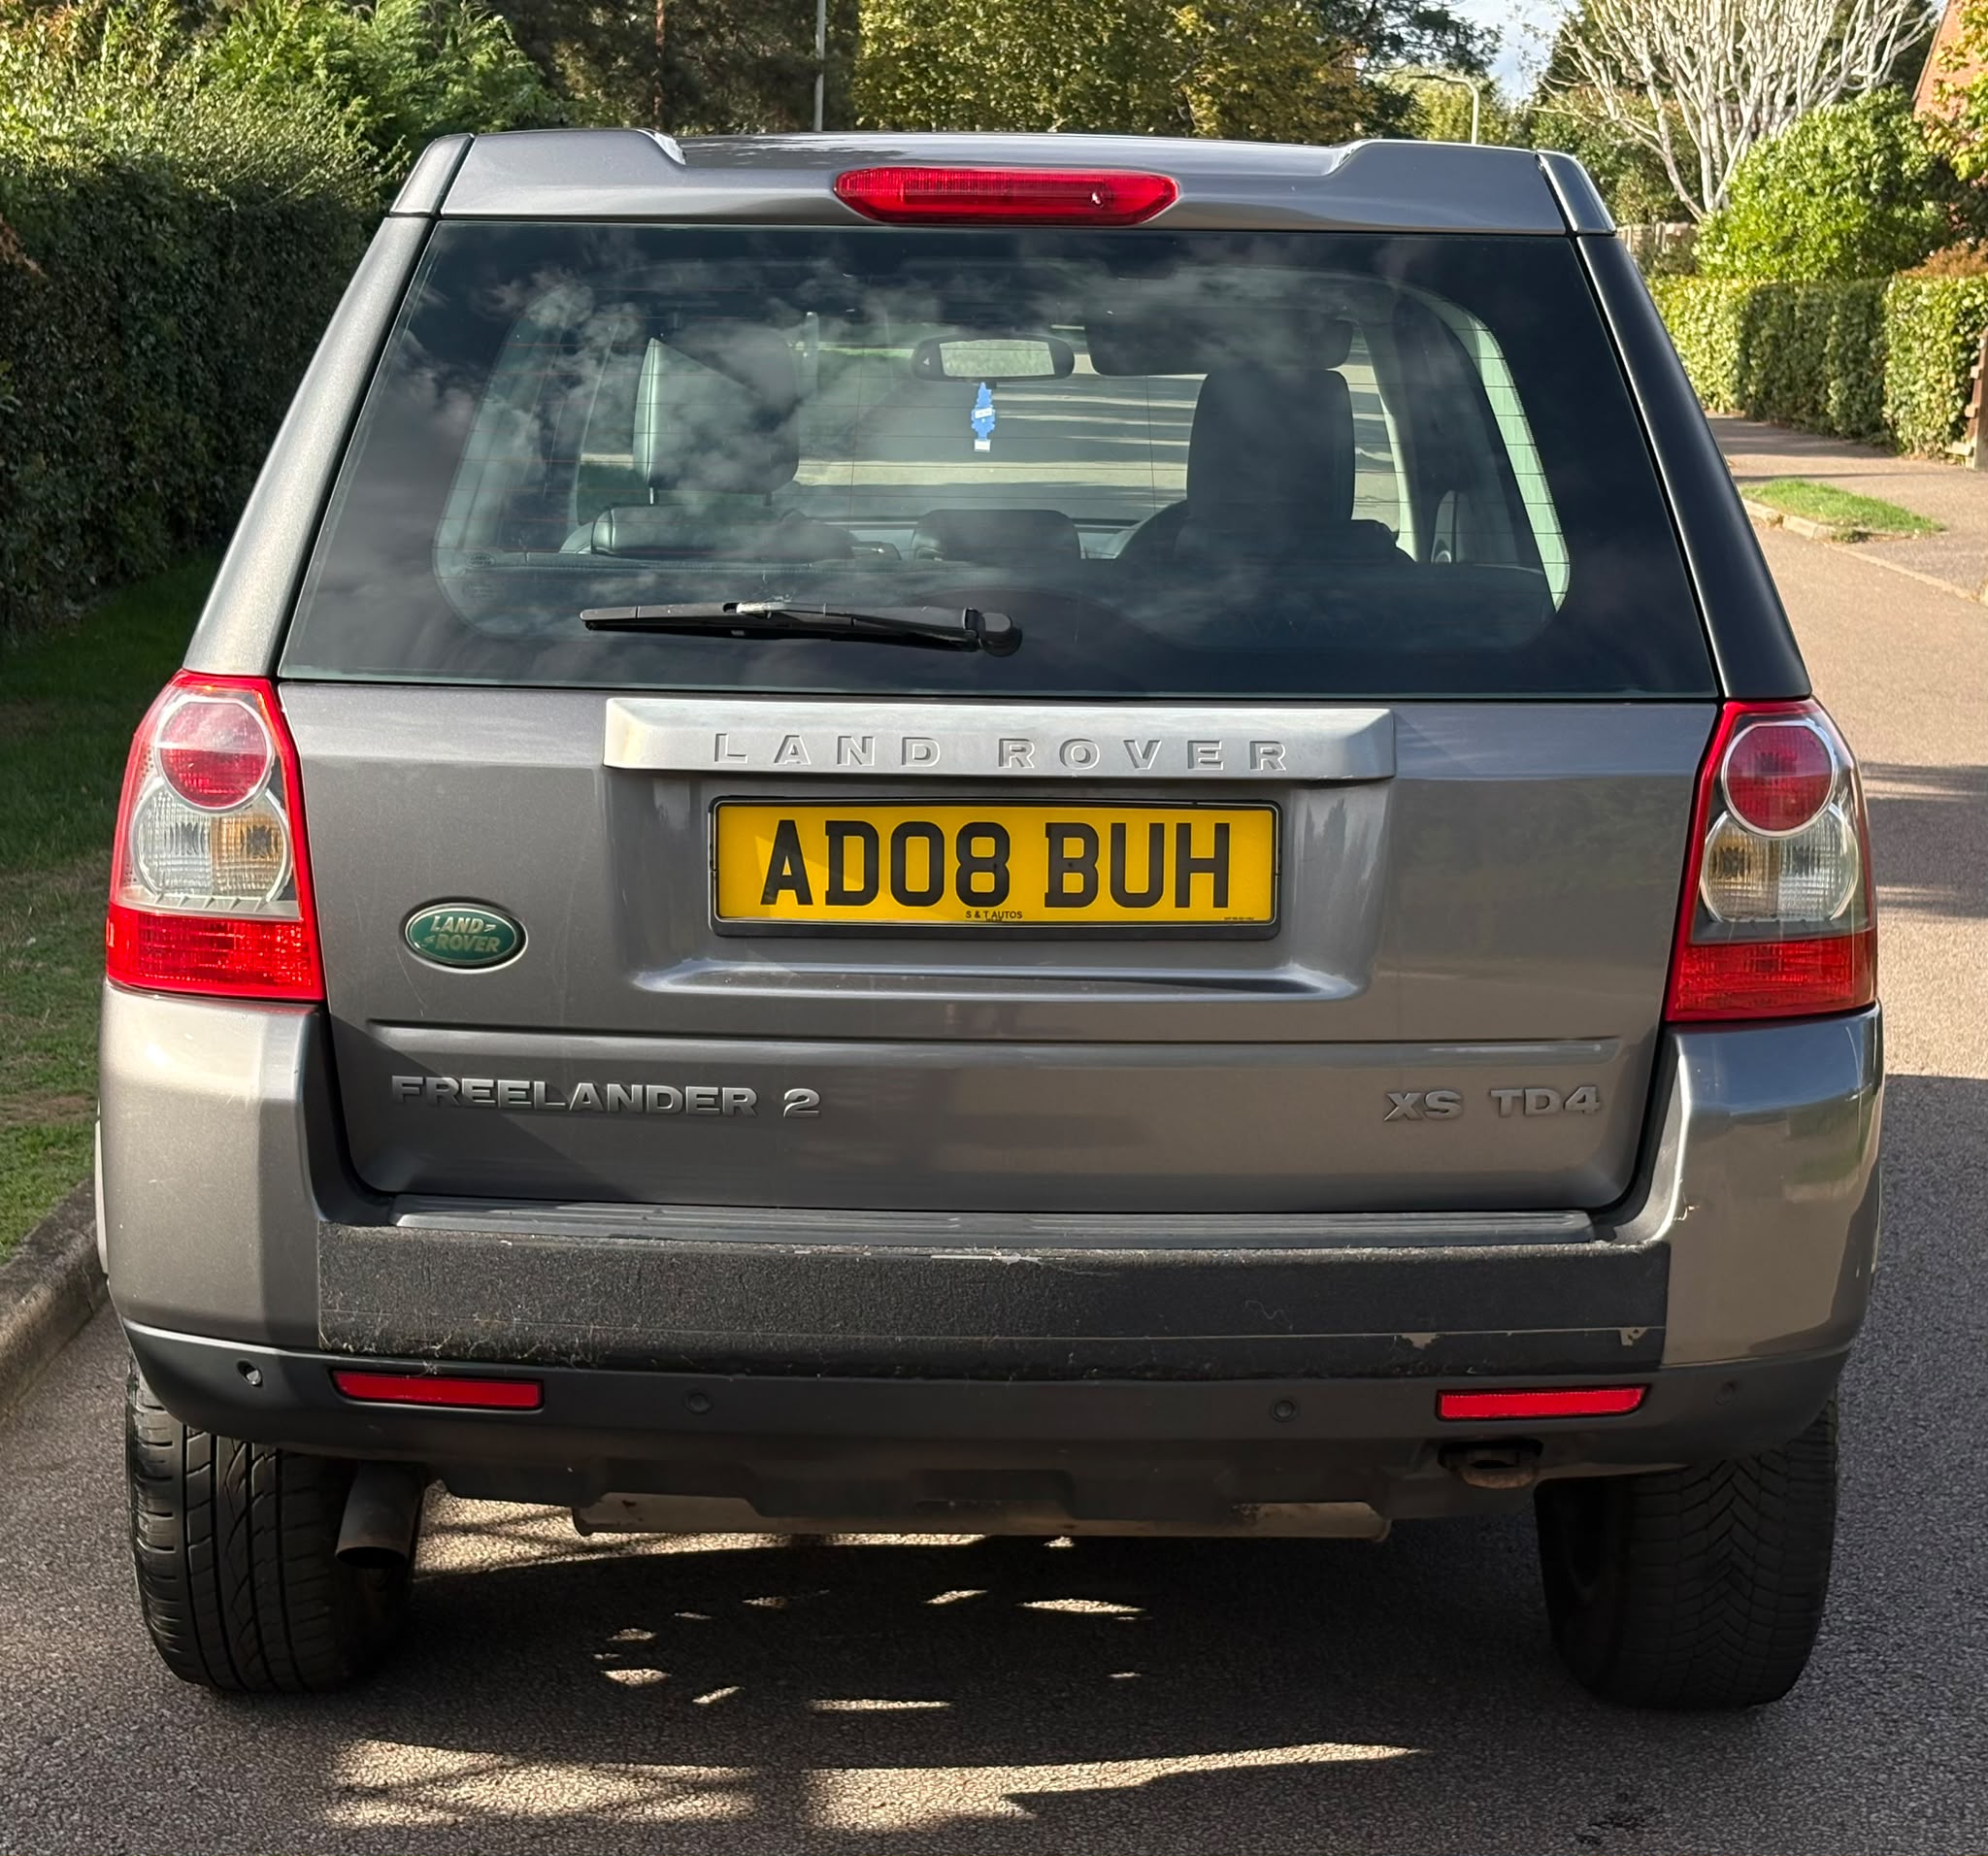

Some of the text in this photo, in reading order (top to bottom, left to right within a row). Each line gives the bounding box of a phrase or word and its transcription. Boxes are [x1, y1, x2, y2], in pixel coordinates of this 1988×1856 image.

[713, 732, 1287, 772] LAND ROVER
[760, 819, 1229, 909] AD08 BUH
[430, 915, 483, 933] LAND
[991, 911, 1023, 919] AUTOS
[434, 934, 501, 951] ROVER
[391, 1075, 820, 1118] FREELANDER 2
[1383, 1085, 1603, 1122] XS TD4
